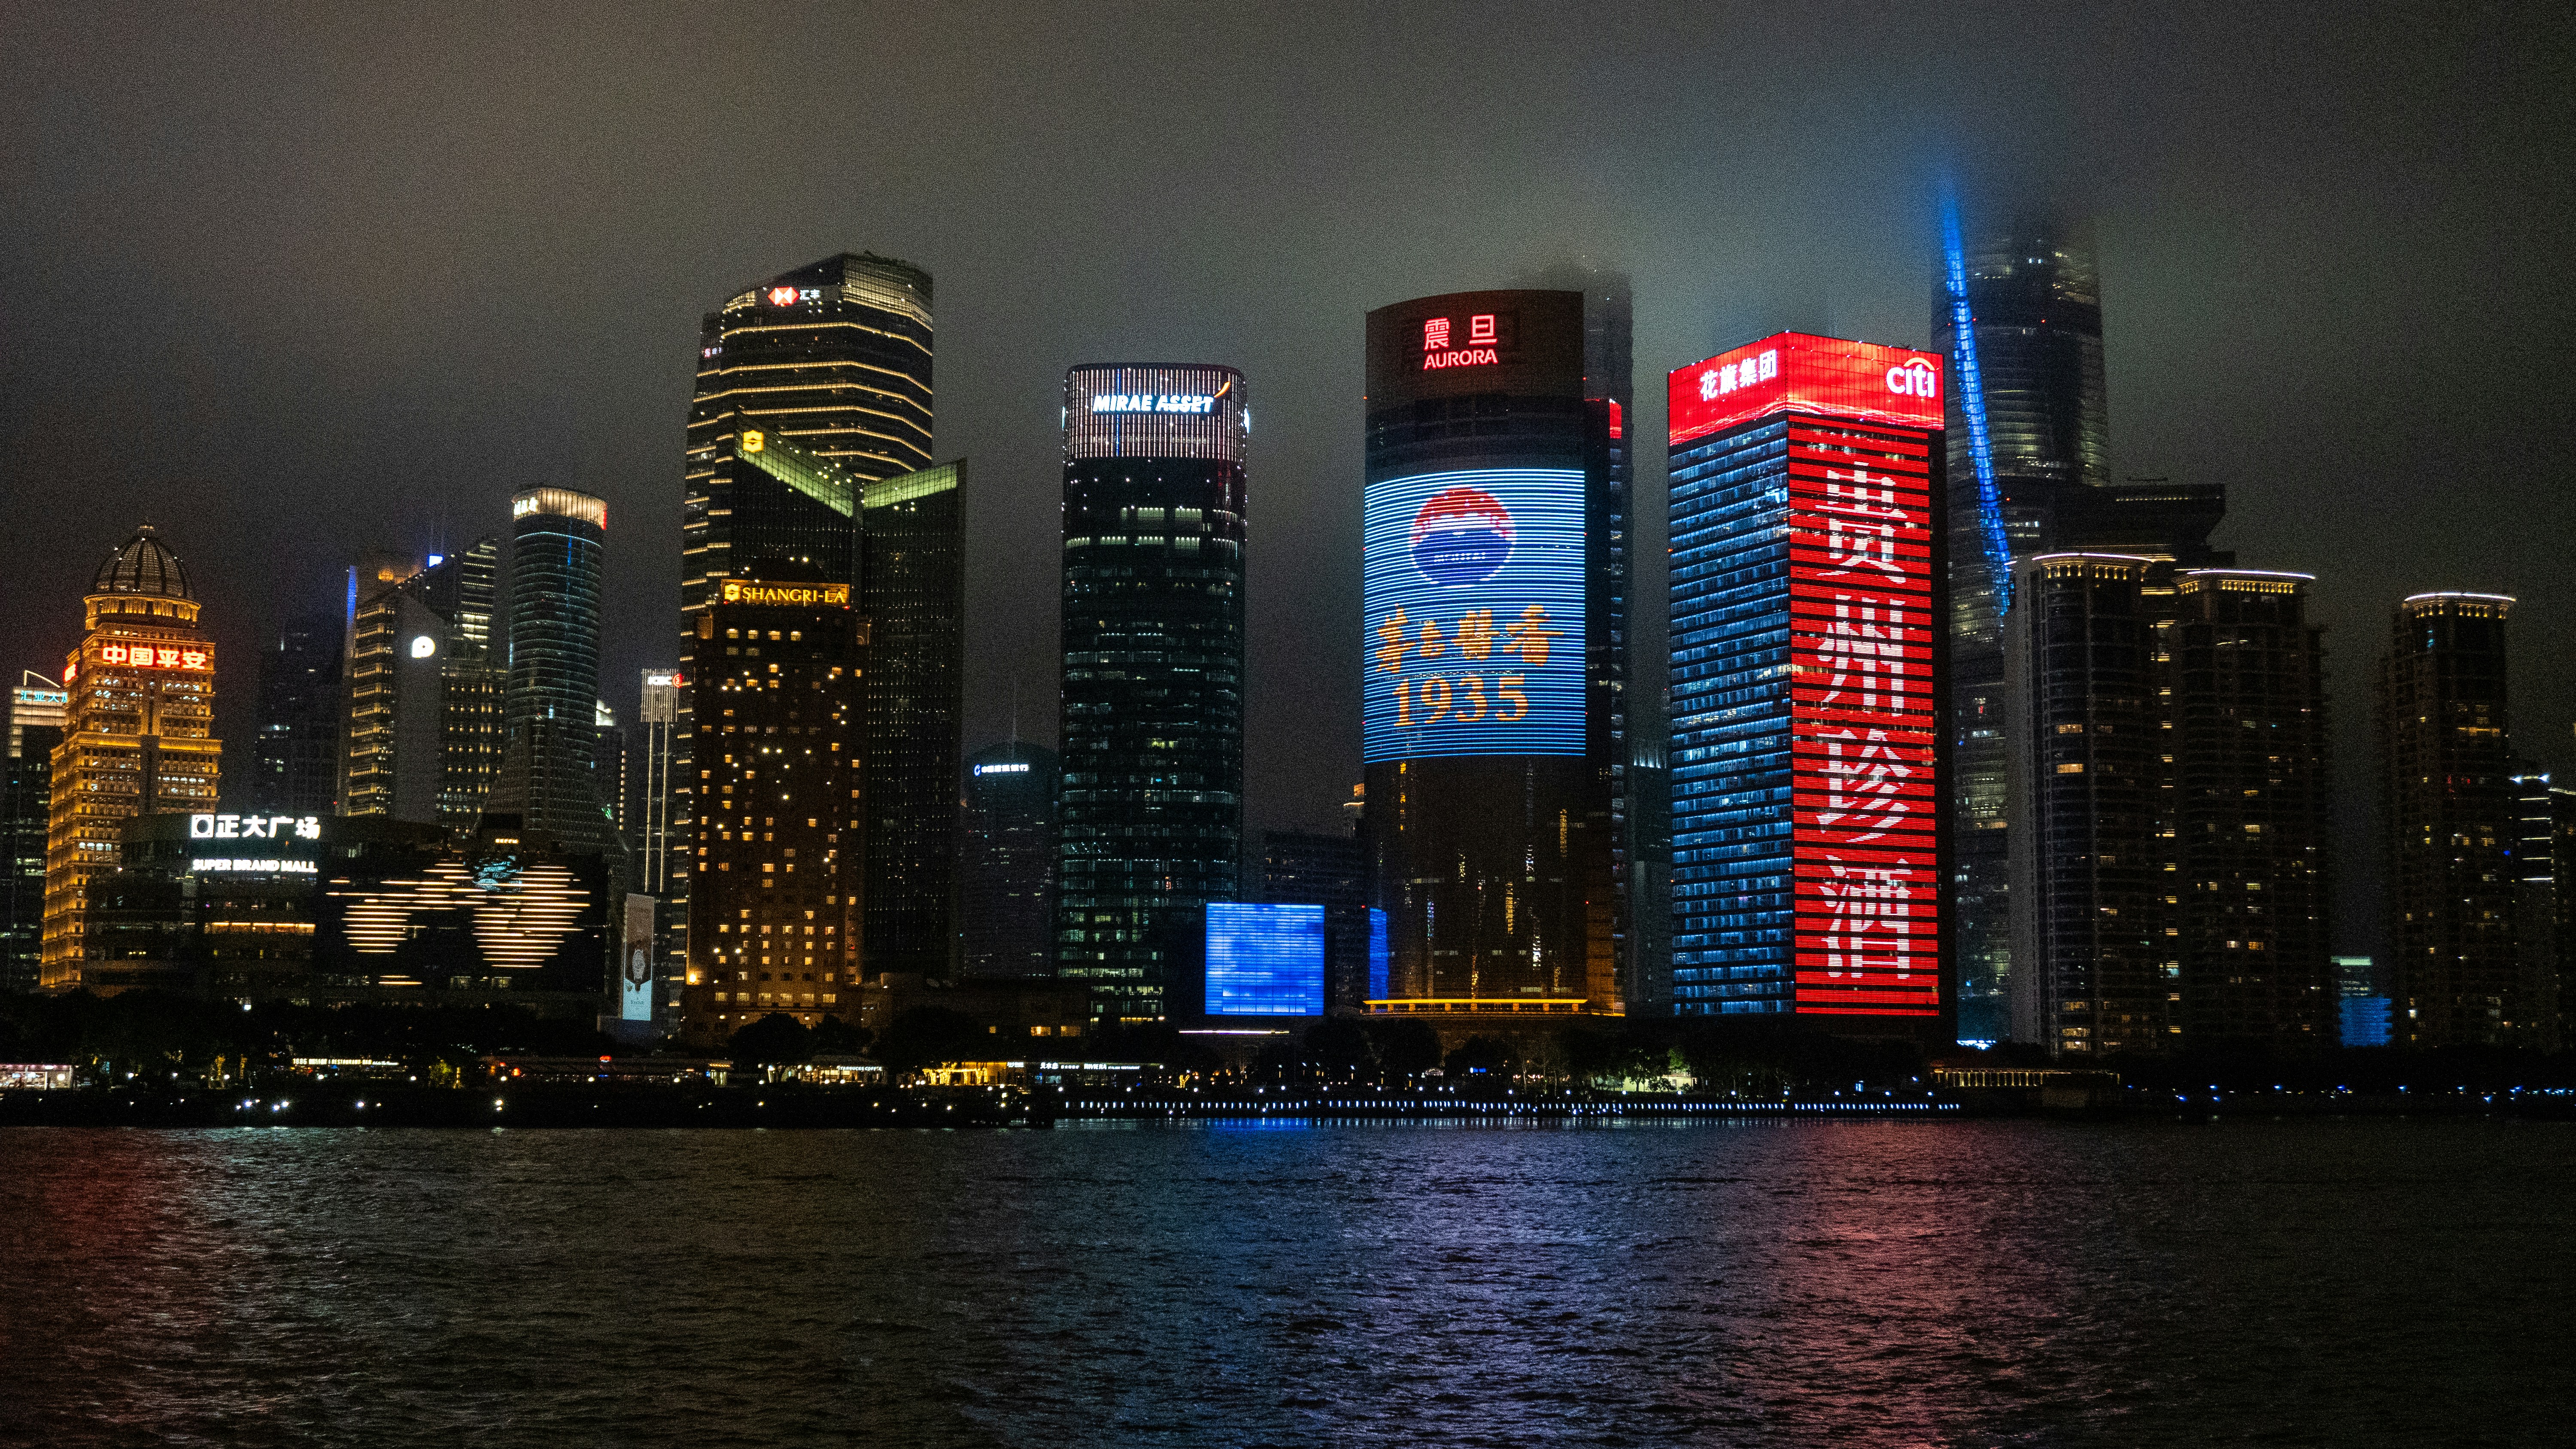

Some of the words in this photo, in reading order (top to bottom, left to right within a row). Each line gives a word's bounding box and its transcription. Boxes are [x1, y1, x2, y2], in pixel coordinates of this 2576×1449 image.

[800, 289, 820, 300] 汇丰
[1424, 315, 1498, 350] 震旦
[1424, 349, 1498, 369] AURORA
[1700, 349, 1776, 401] 花旗集团
[1886, 358, 1935, 398] citi
[1093, 394, 1152, 412] MIRAE
[1155, 394, 1214, 412] ASSET
[742, 587, 845, 603] SHANGRI-LA
[103, 646, 206, 670] 中国平安
[1392, 674, 1529, 726] 1935
[1816, 461, 1912, 980] 贵州珍酒
[216, 815, 321, 839] 正大广场
[193, 859, 232, 871] SUPER
[233, 859, 280, 871] BRAND
[281, 860, 319, 873] MALL
